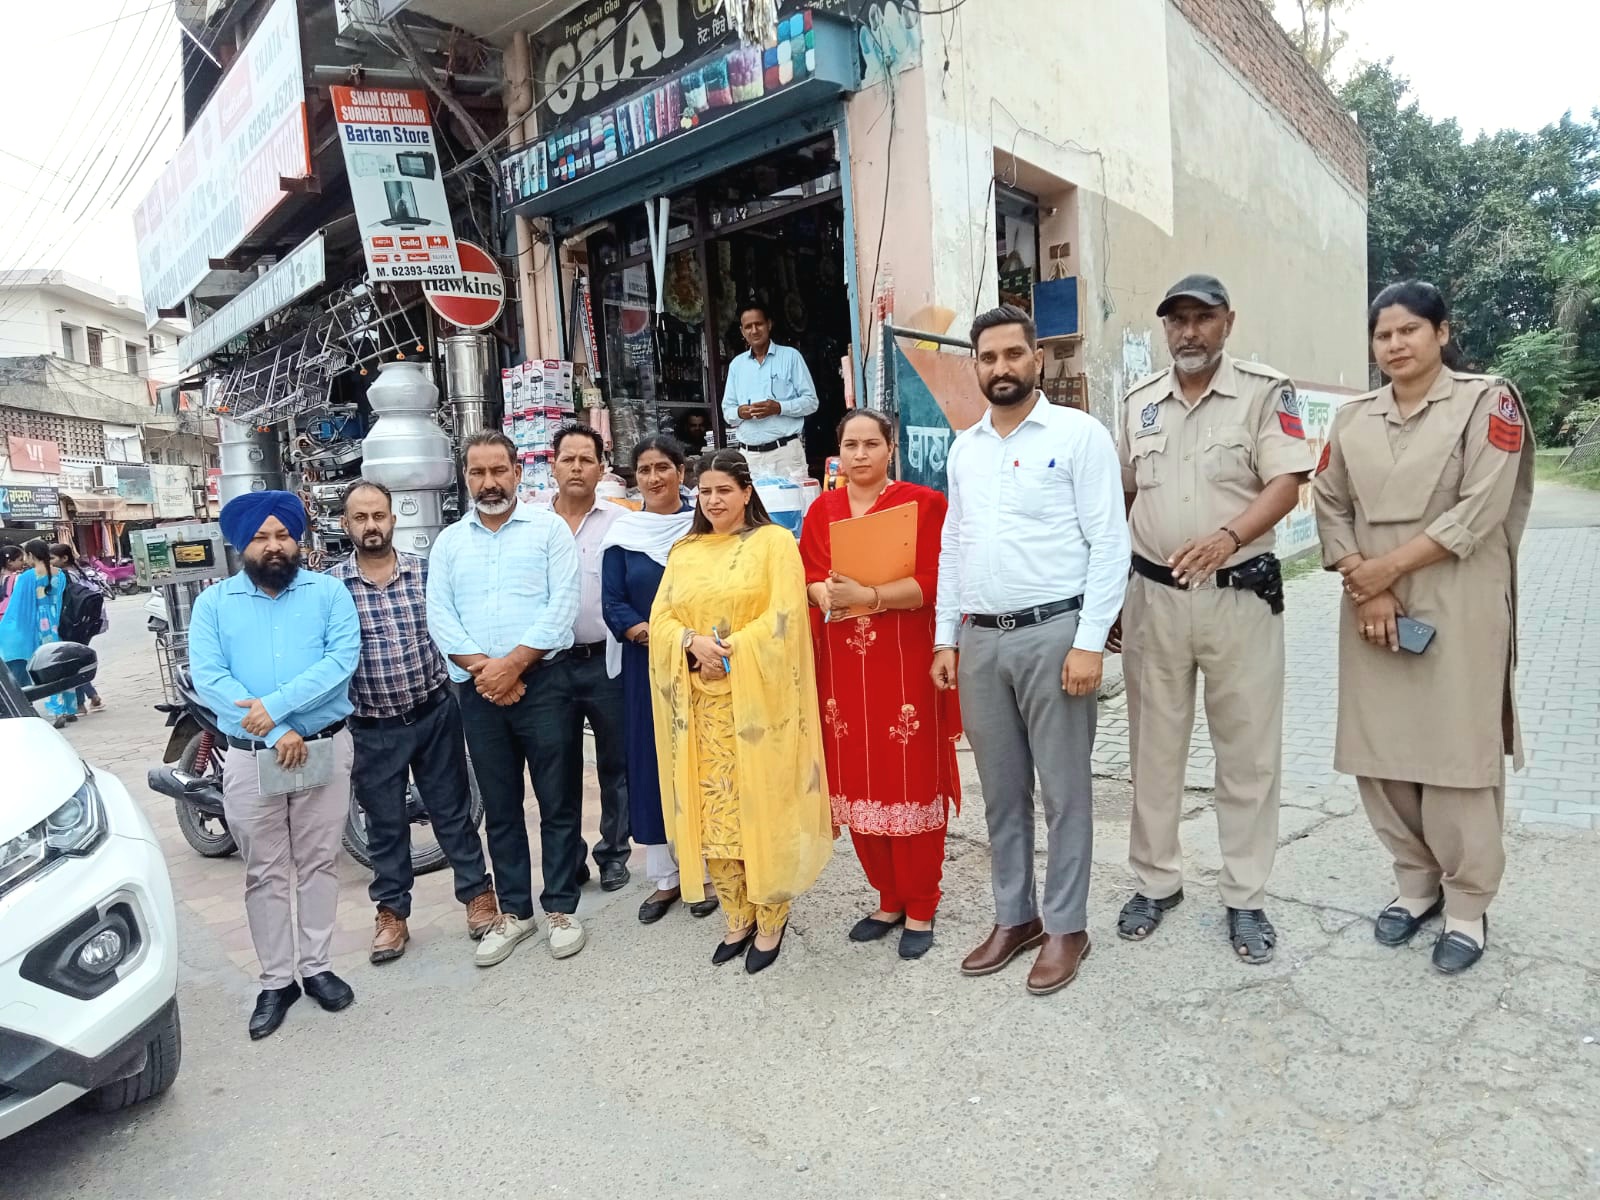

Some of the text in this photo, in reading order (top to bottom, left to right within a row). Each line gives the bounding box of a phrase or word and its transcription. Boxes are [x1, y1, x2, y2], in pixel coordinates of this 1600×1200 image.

[565, 0, 624, 38] Prop: Sumit Ghai
[545, 0, 684, 115] GHAI
[351, 91, 411, 108] SHAM GOPAL
[341, 107, 426, 123] SURINDER KUMAR
[345, 125, 430, 143] Bartan Store
[401, 239, 420, 247] cello
[376, 264, 456, 277] M. 62393-45281
